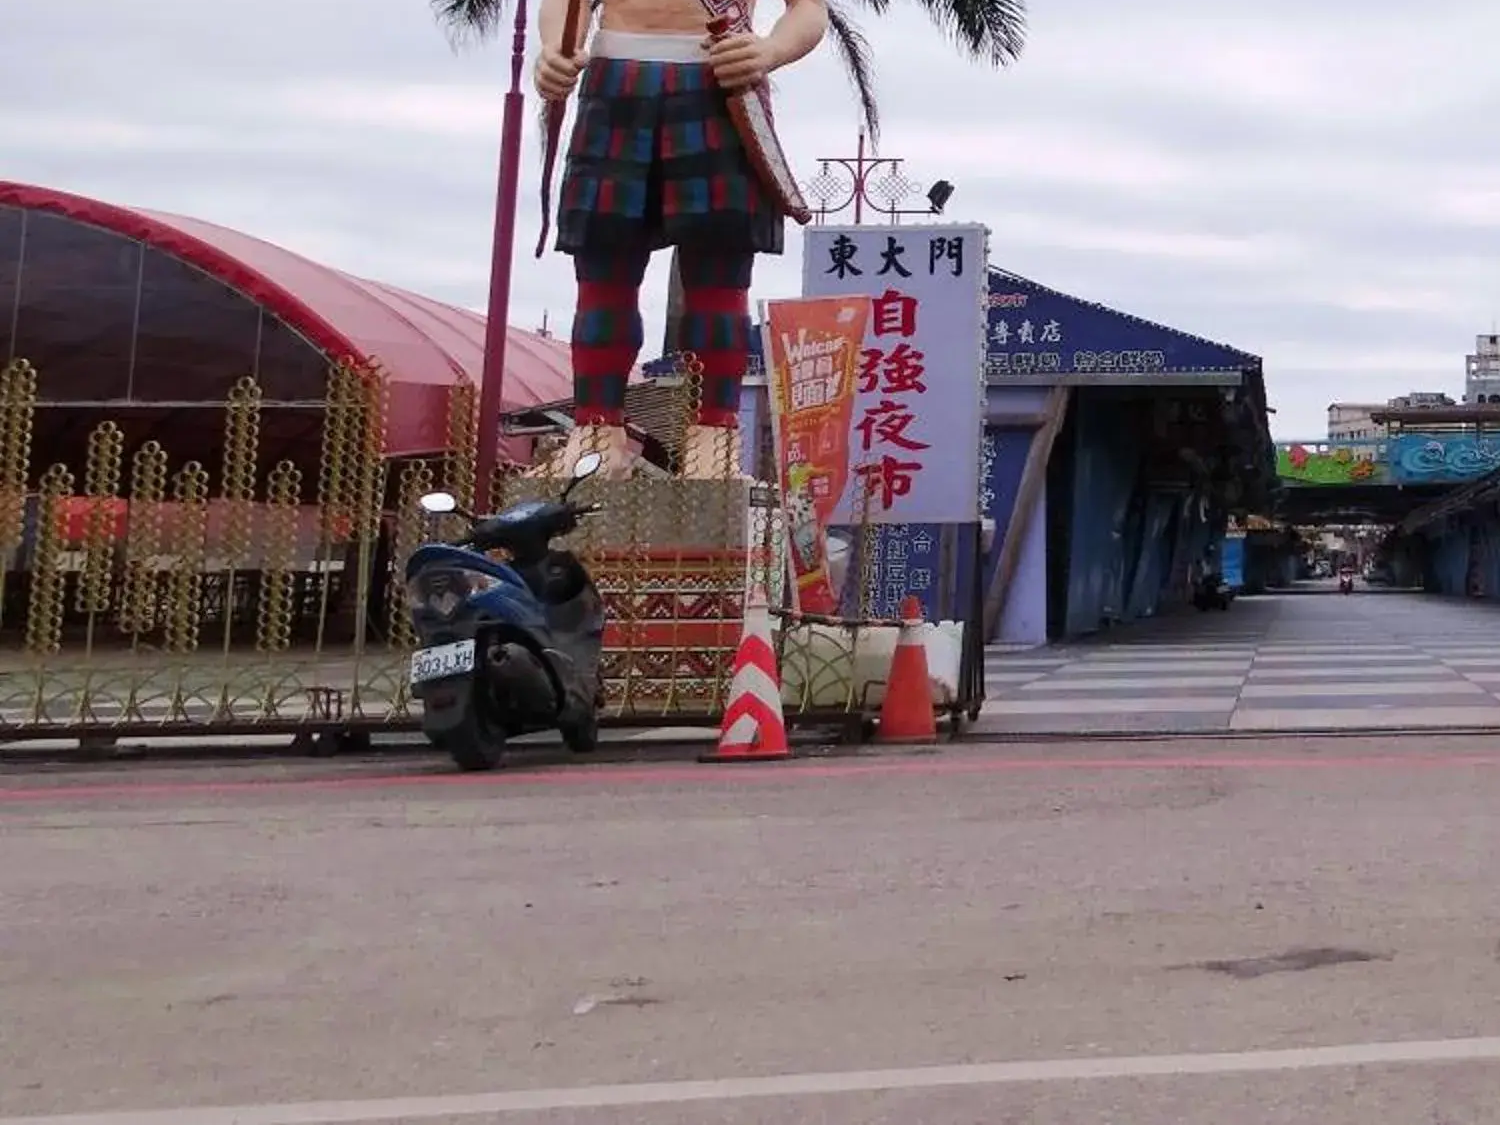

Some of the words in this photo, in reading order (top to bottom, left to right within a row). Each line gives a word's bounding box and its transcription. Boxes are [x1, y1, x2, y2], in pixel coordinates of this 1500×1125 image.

[825, 235, 964, 280] 東大門
[854, 288, 932, 511] 自強夜市
